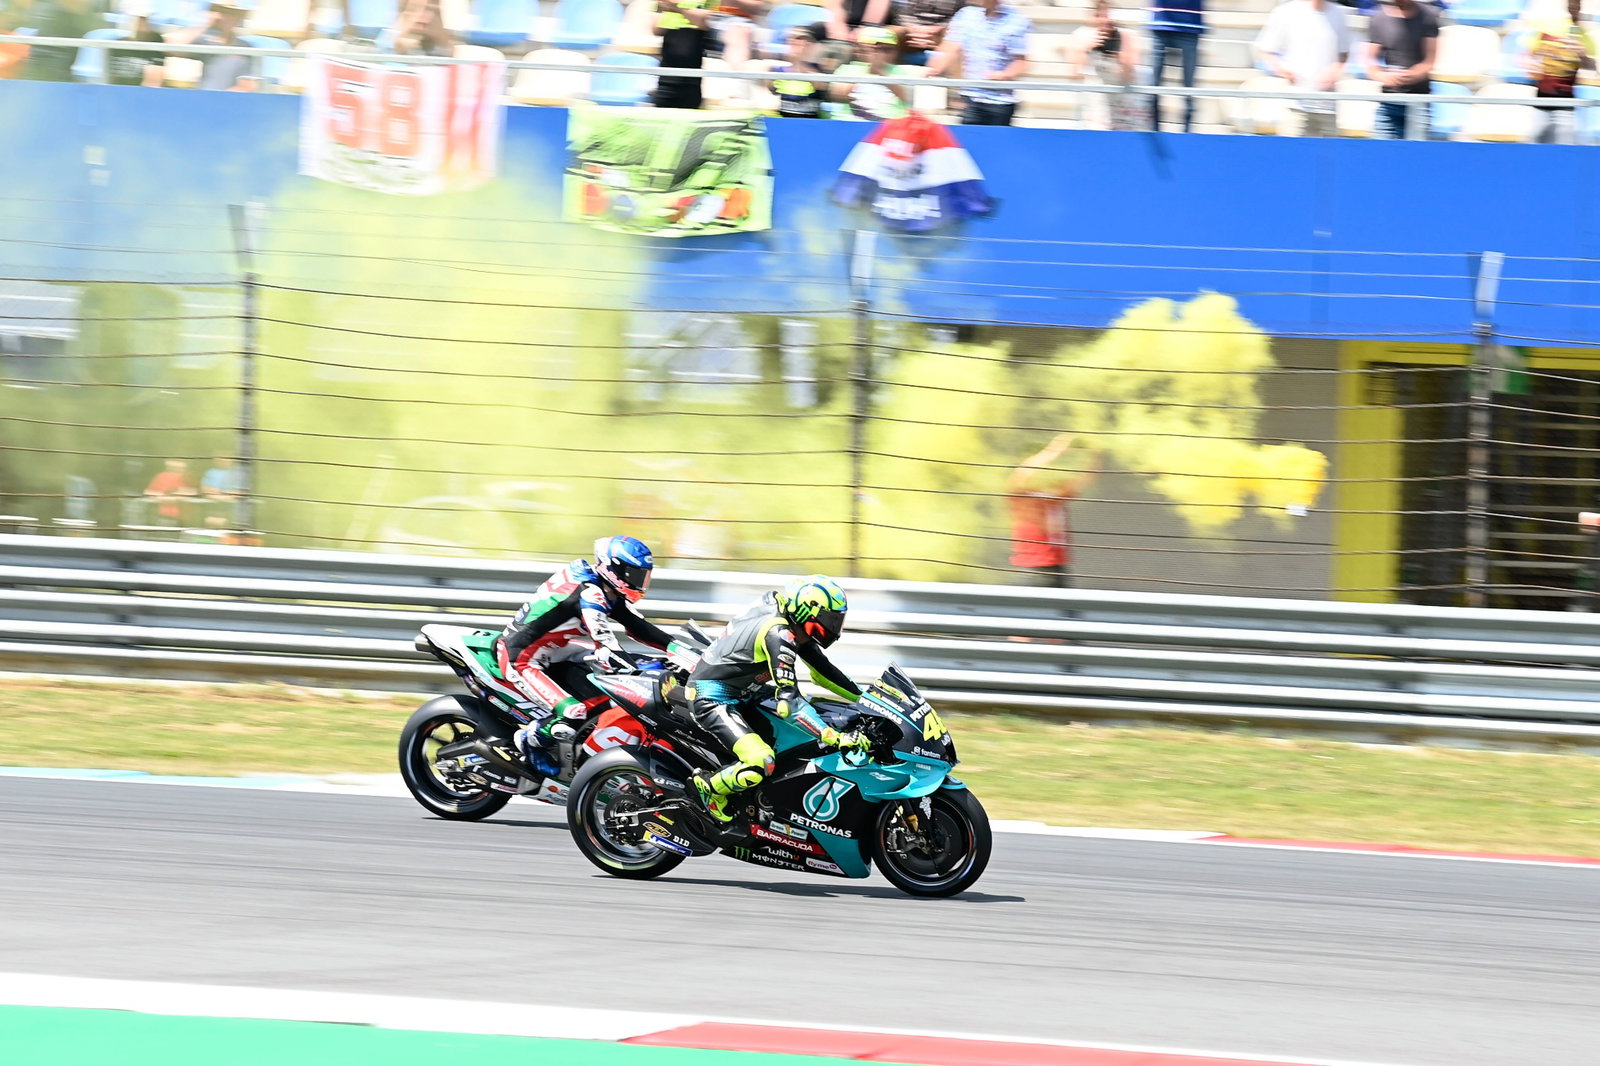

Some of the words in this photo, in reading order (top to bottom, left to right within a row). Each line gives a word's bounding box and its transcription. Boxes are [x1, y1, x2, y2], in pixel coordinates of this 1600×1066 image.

[324, 63, 423, 158] 58
[859, 697, 903, 724] PETRONAS
[921, 748, 941, 759] fantom
[790, 813, 852, 838] PETRONAS
[673, 835, 690, 847] DID
[757, 829, 813, 852] BARRACUDA
[752, 853, 805, 871] MONSTER
